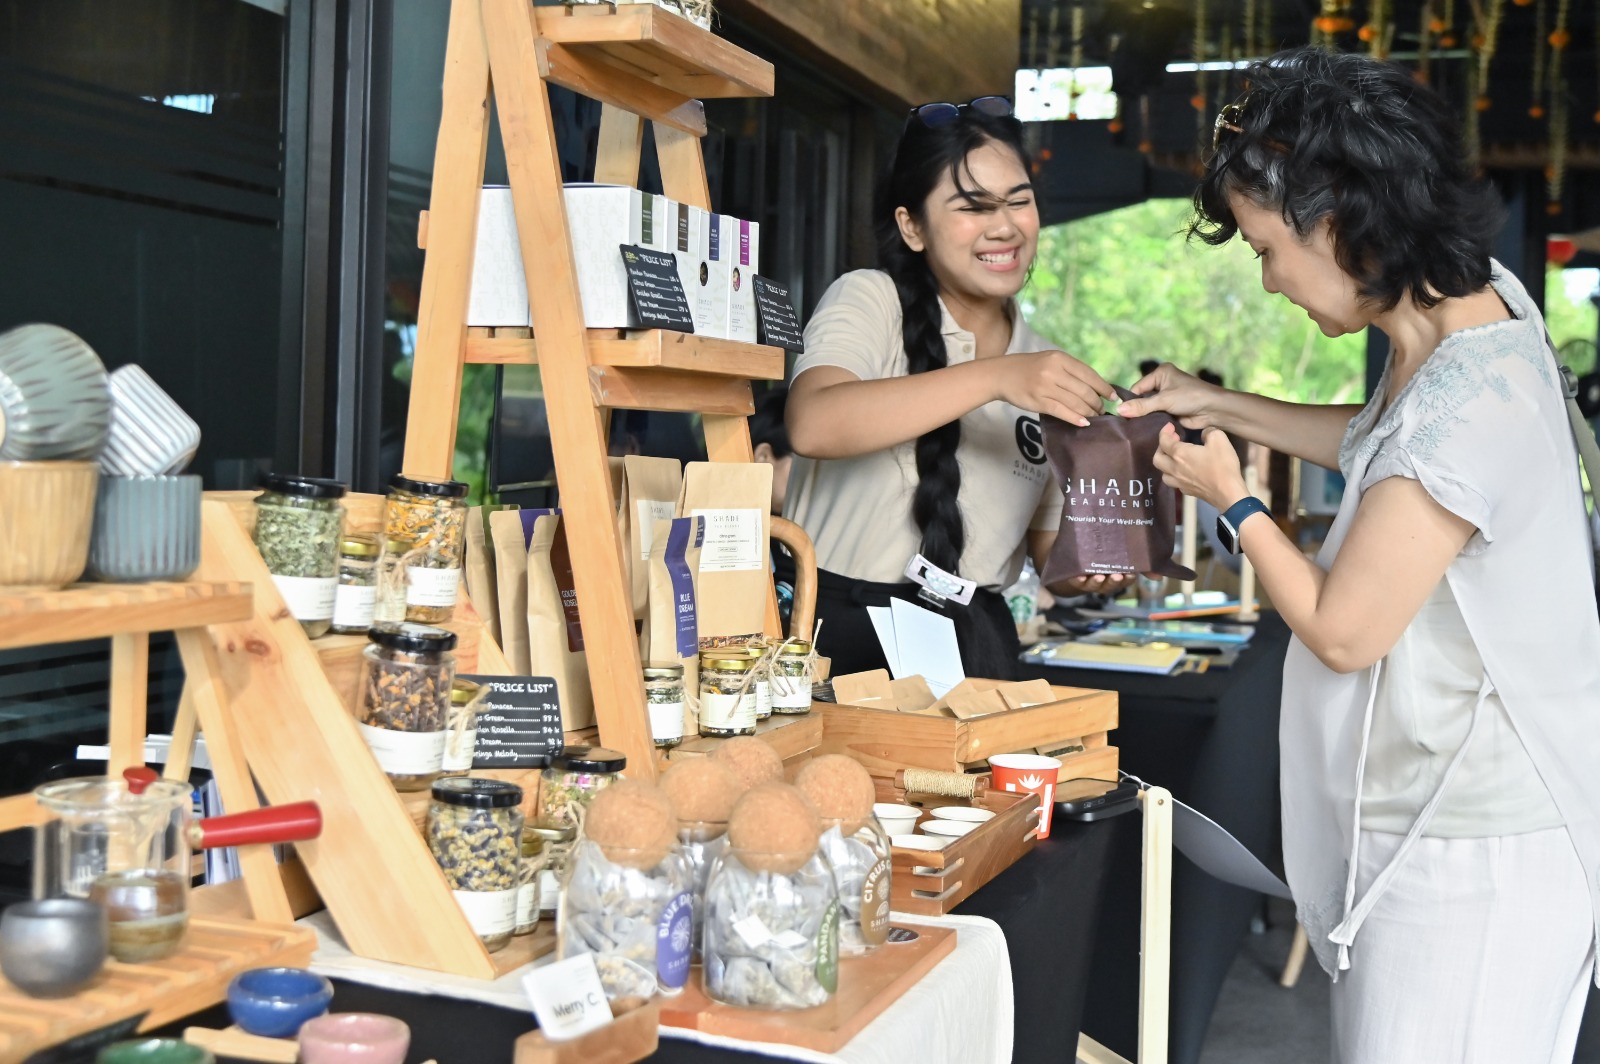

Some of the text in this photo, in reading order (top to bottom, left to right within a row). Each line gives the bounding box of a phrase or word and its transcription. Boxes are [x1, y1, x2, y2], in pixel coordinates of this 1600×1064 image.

[680, 593, 690, 602] BLUE
[679, 603, 694, 613] DREAM
[528, 683, 553, 693] LIST"
[494, 749, 518, 762] Melody
[864, 860, 886, 903] CITRUS
[658, 900, 680, 938] BLUE
[553, 1000, 585, 1018] Merry
